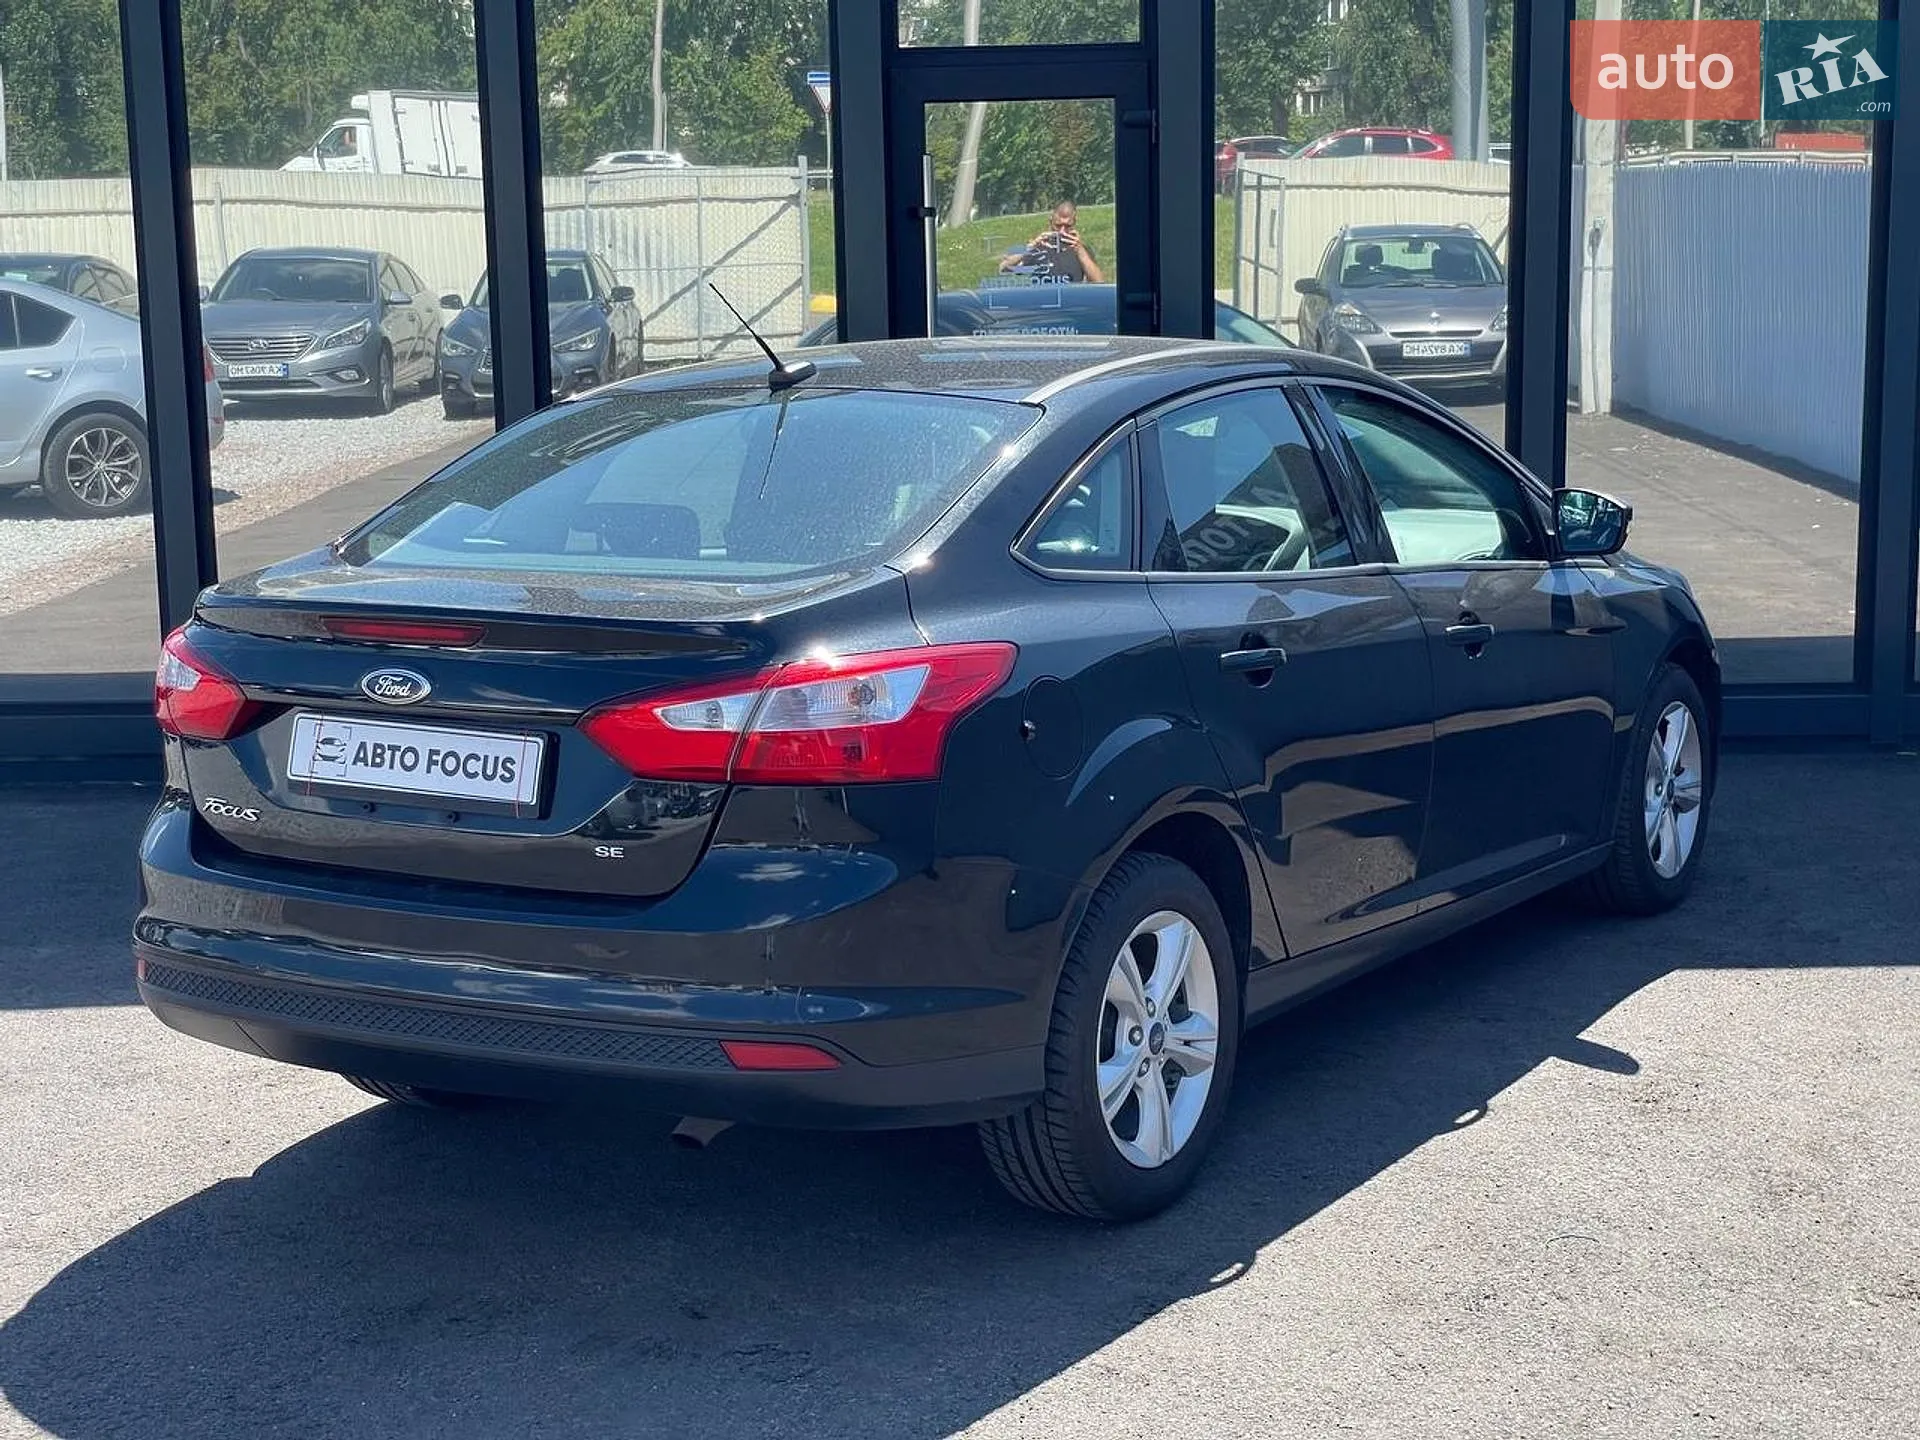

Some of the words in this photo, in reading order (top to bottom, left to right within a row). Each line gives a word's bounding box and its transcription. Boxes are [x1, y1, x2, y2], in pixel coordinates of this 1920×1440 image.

[375, 675, 411, 696] Ford
[425, 748, 517, 783] FOCUS
[595, 845, 625, 858] SE
